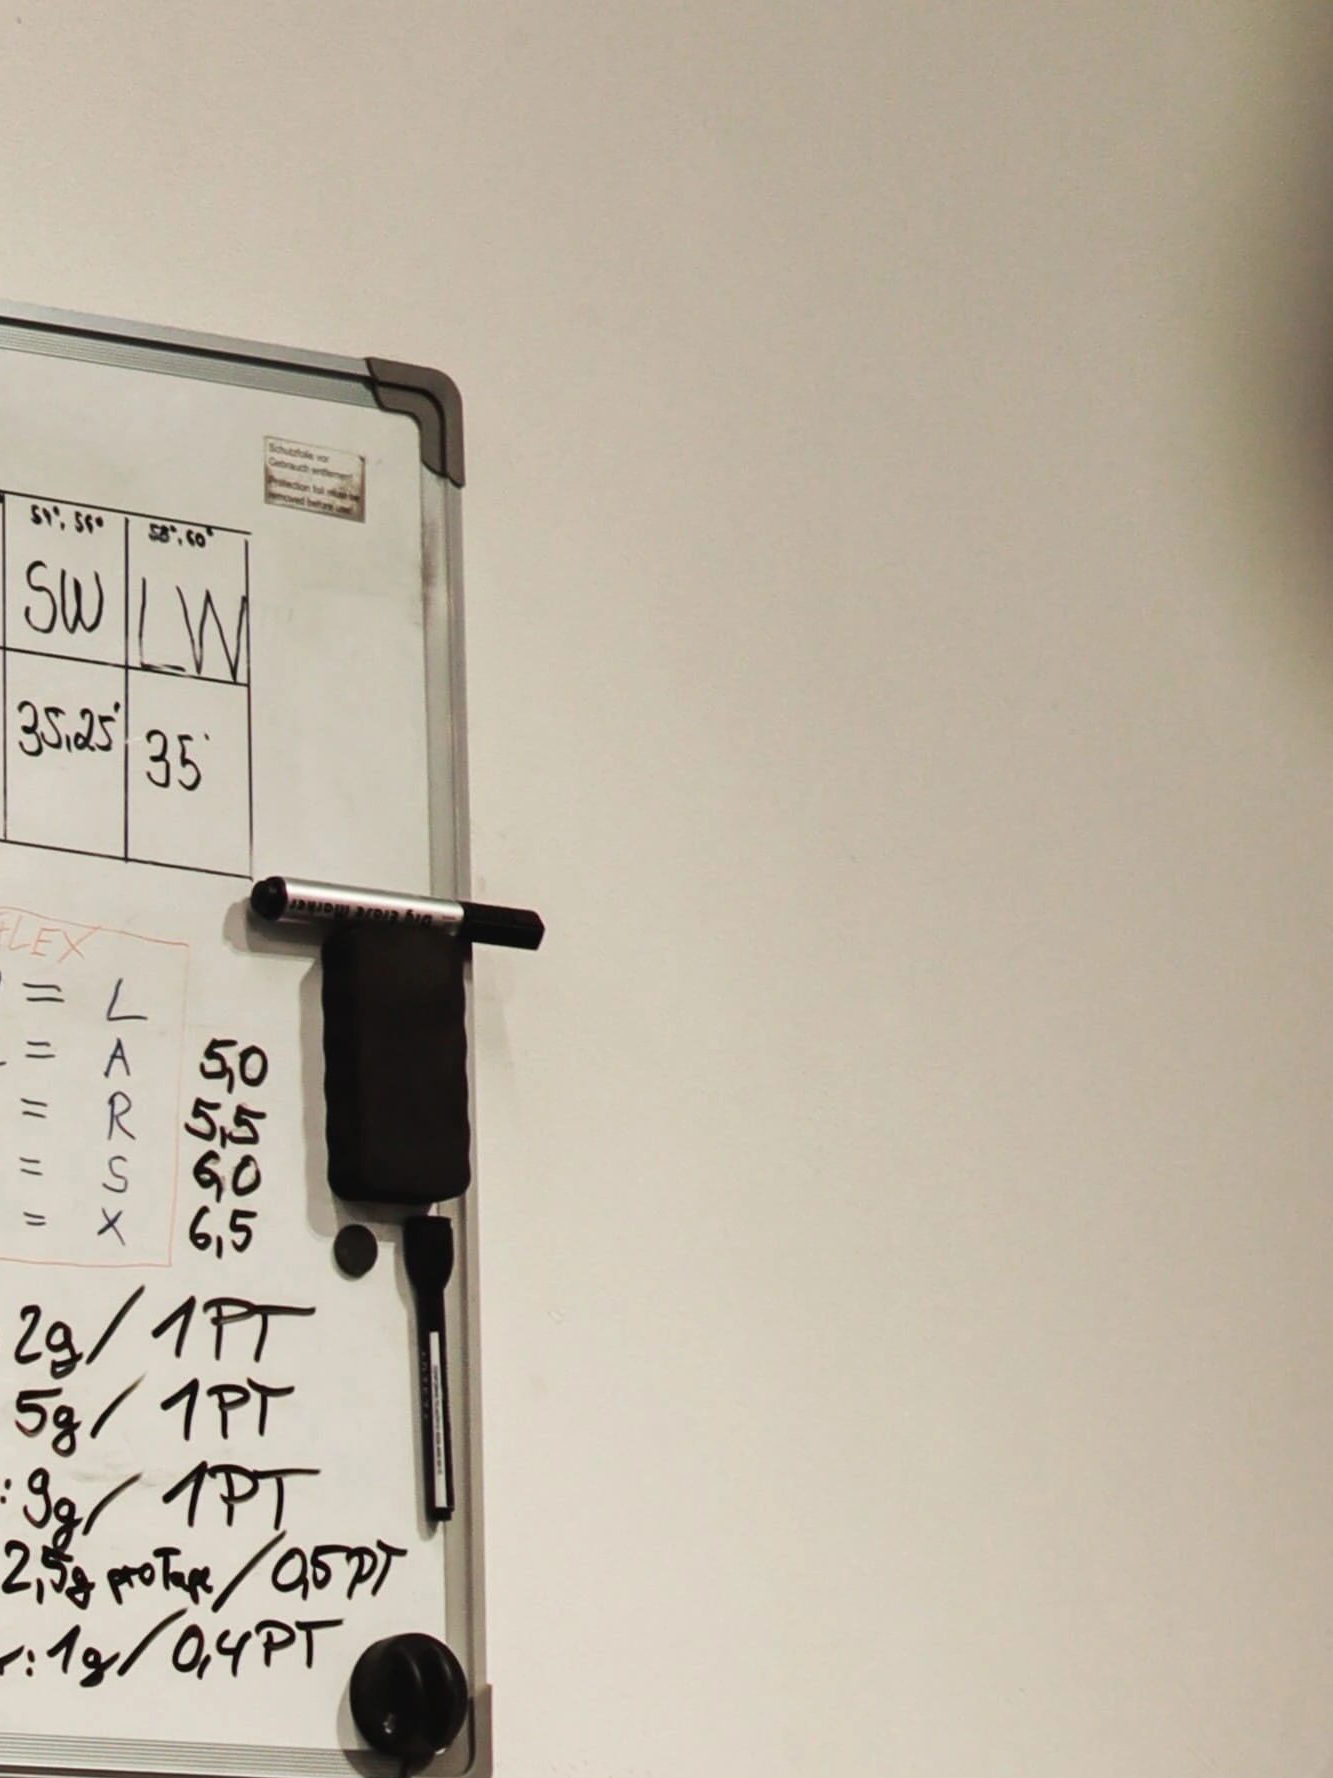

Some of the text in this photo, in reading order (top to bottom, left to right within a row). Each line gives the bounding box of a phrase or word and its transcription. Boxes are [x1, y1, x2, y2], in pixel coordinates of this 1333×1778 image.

[25, 561, 105, 634] SW
[139, 576, 250, 685] LW
[106, 977, 148, 1022] L
[104, 1037, 131, 1078] A
[199, 1038, 269, 1094] 5,0
[107, 1091, 136, 1140] R
[184, 1097, 267, 1148] 5,5
[102, 1155, 130, 1193] S
[192, 1151, 262, 1202] 6,0
[97, 1208, 127, 1246] X
[188, 1206, 259, 1259] 6,5
